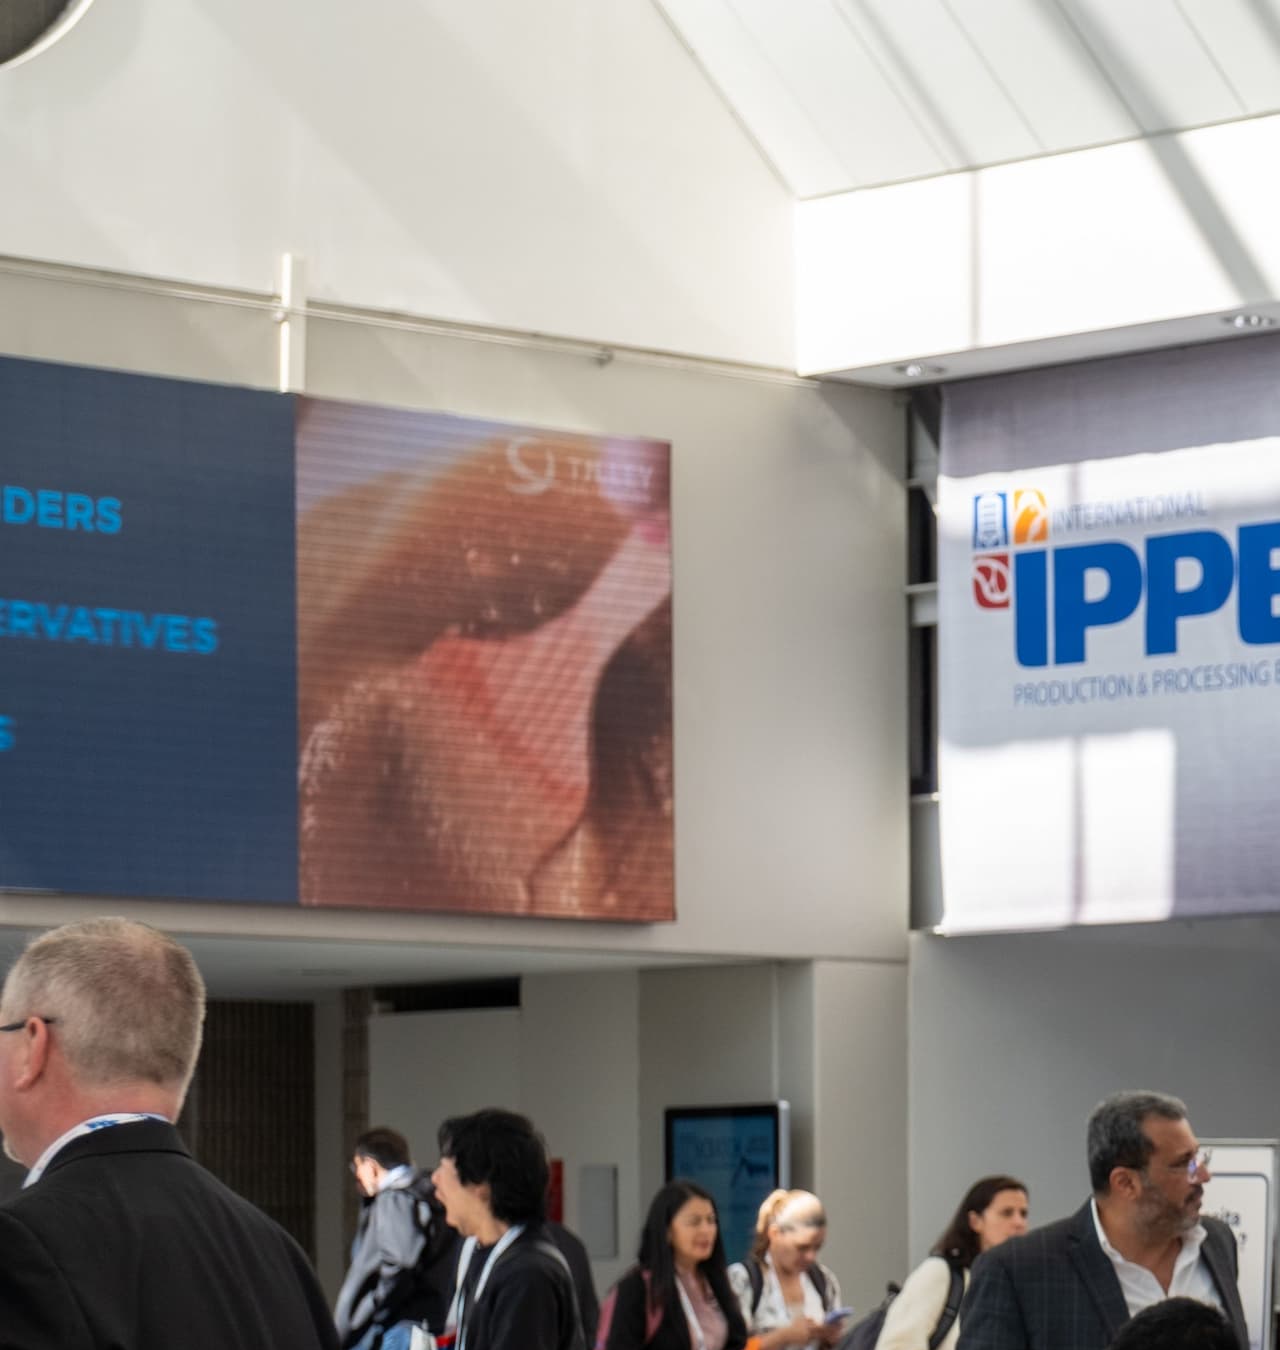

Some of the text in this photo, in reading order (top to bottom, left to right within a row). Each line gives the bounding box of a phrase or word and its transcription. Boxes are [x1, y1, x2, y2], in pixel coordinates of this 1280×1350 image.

[1052, 491, 1208, 532] INTERNATIONAL
[1014, 673, 1133, 707] PRODUCTION
[1135, 672, 1149, 697] &
[1152, 658, 1271, 693] PROCESSING
